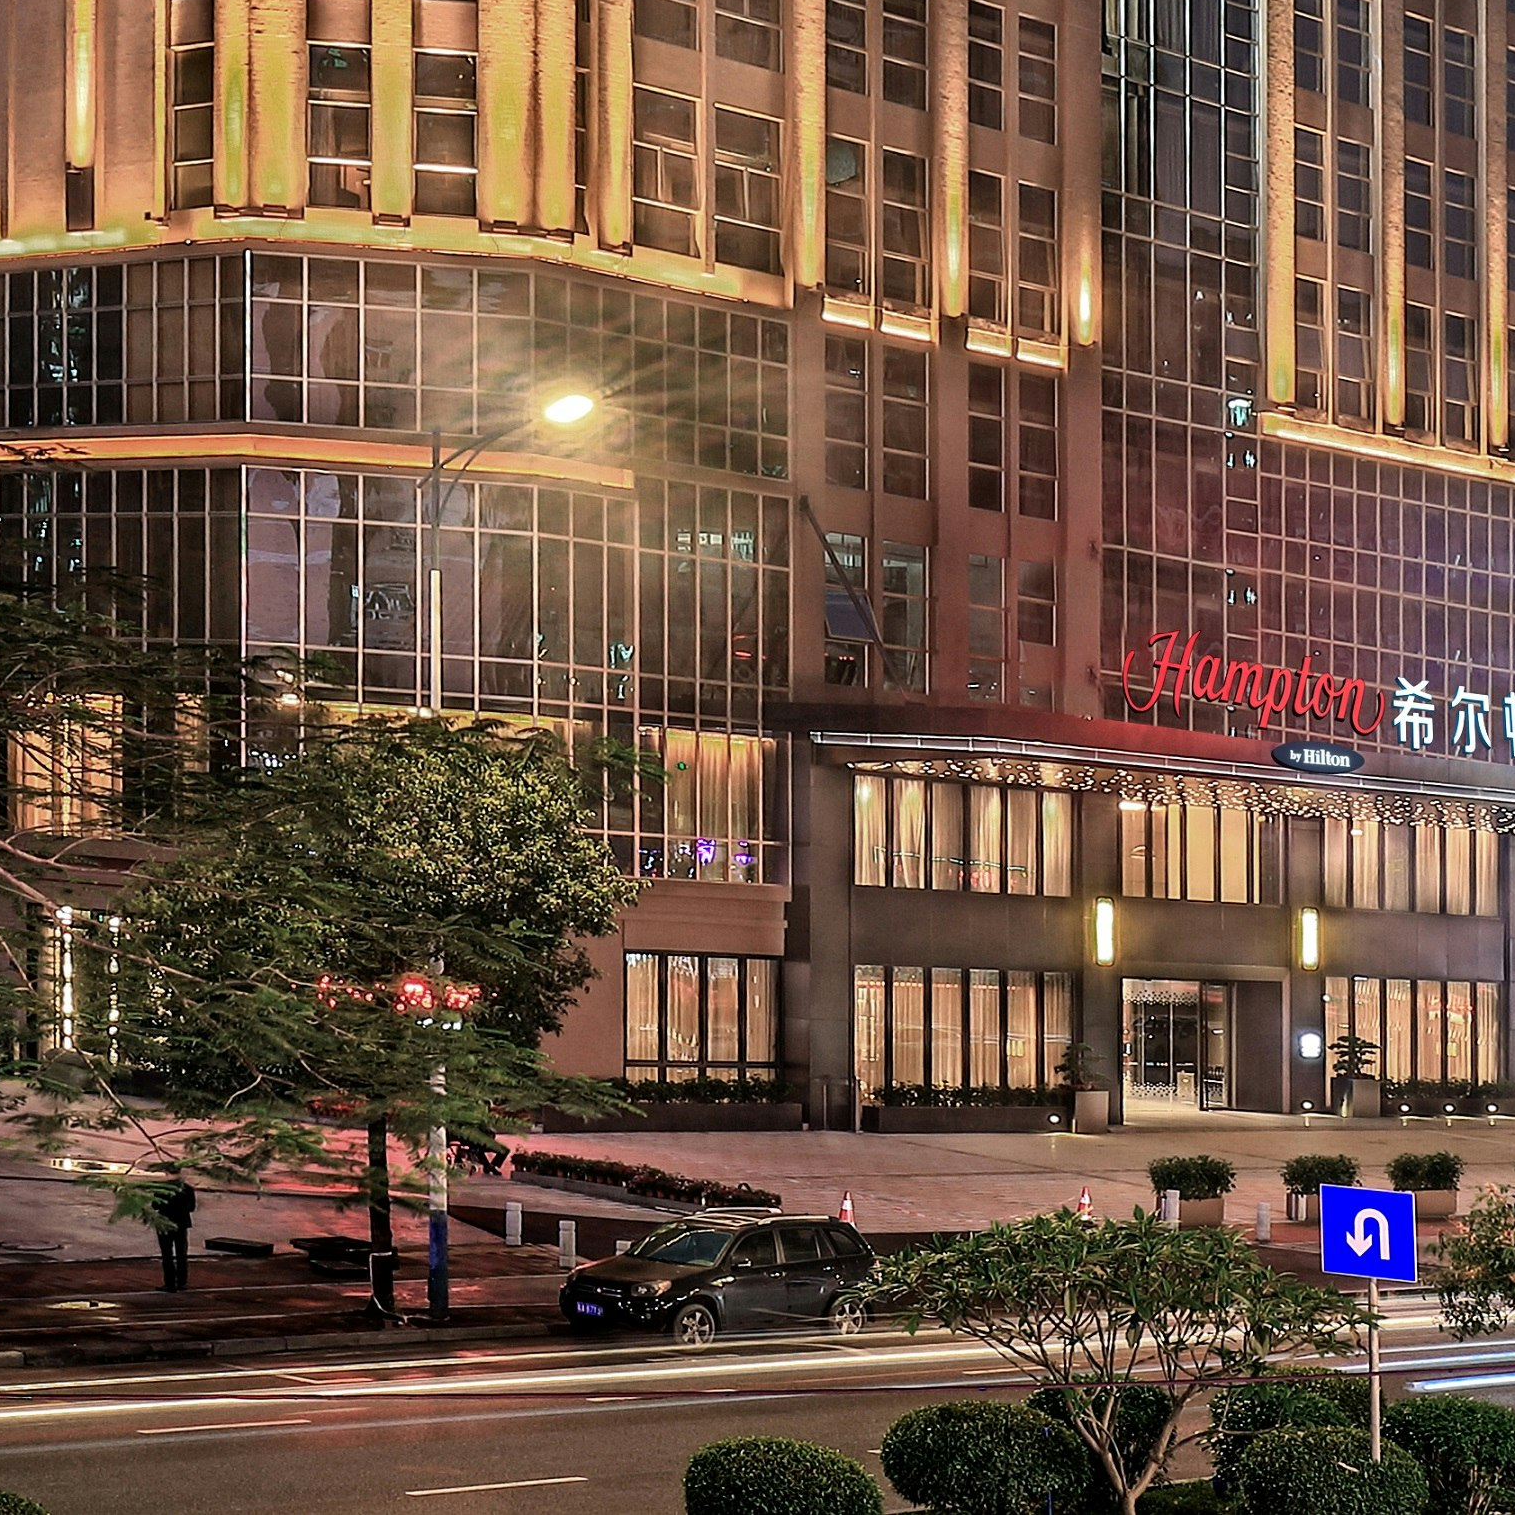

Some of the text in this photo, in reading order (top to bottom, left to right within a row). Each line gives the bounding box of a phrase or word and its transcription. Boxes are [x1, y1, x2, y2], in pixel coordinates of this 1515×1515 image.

[1123, 629, 1385, 735] Hampton
[1289, 748, 1351, 767] by Hilton
